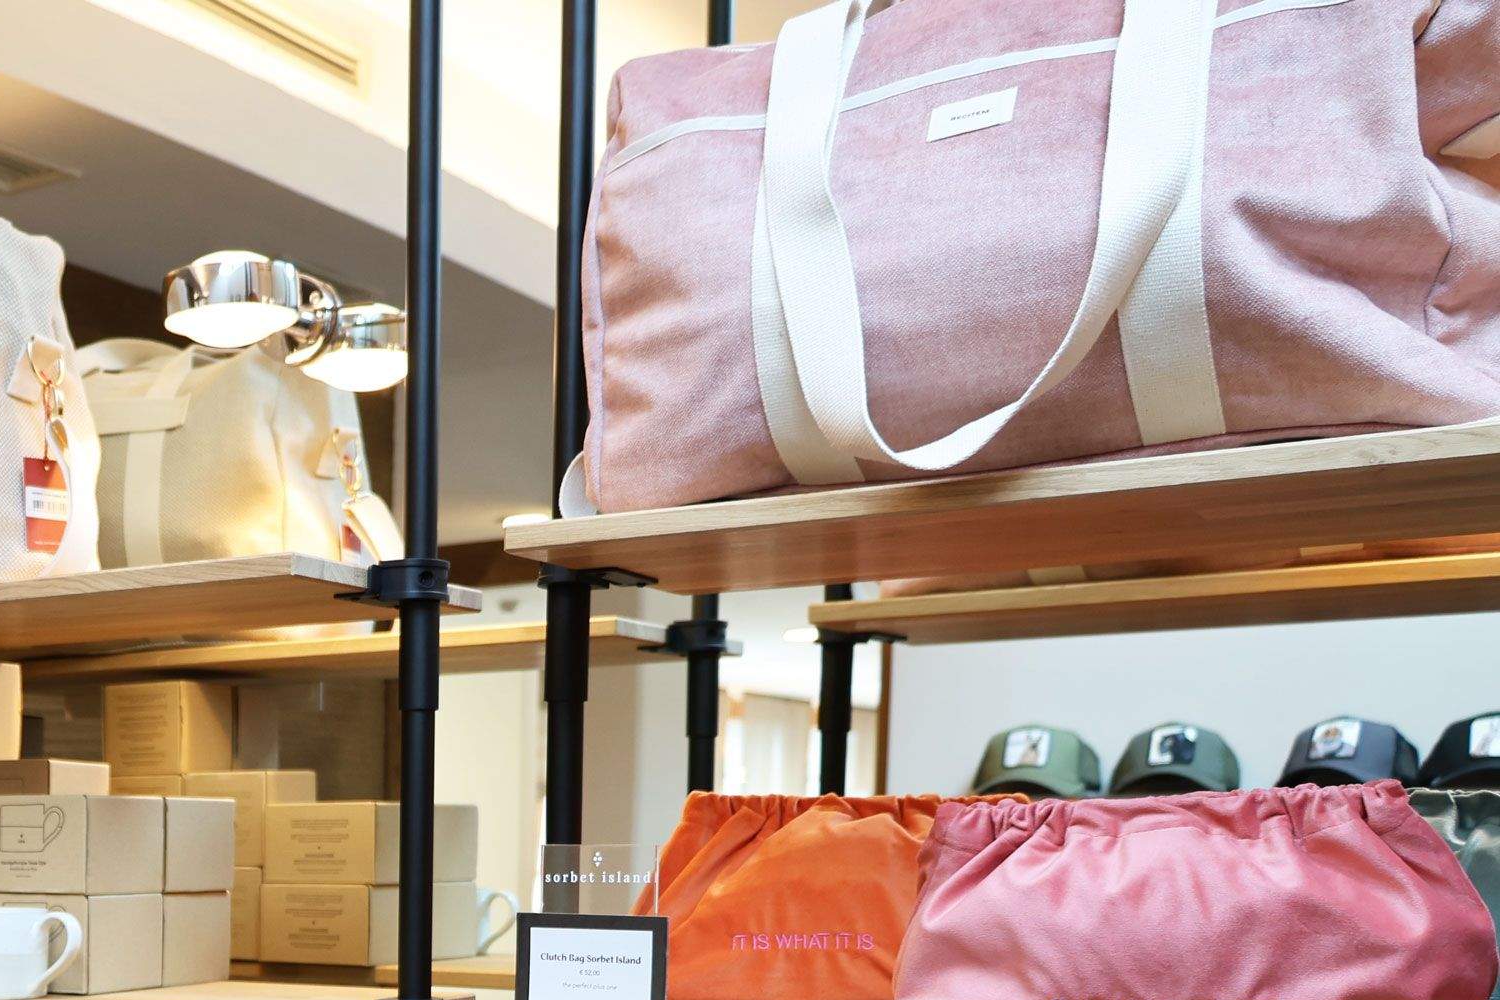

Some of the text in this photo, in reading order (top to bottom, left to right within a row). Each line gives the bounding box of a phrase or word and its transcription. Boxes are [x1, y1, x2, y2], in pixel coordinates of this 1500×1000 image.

[545, 871, 651, 883] sorbet island
[732, 932, 875, 950] IT IS WHAT IT IS
[540, 952, 641, 965] Clutch Bag Sorbet Island
